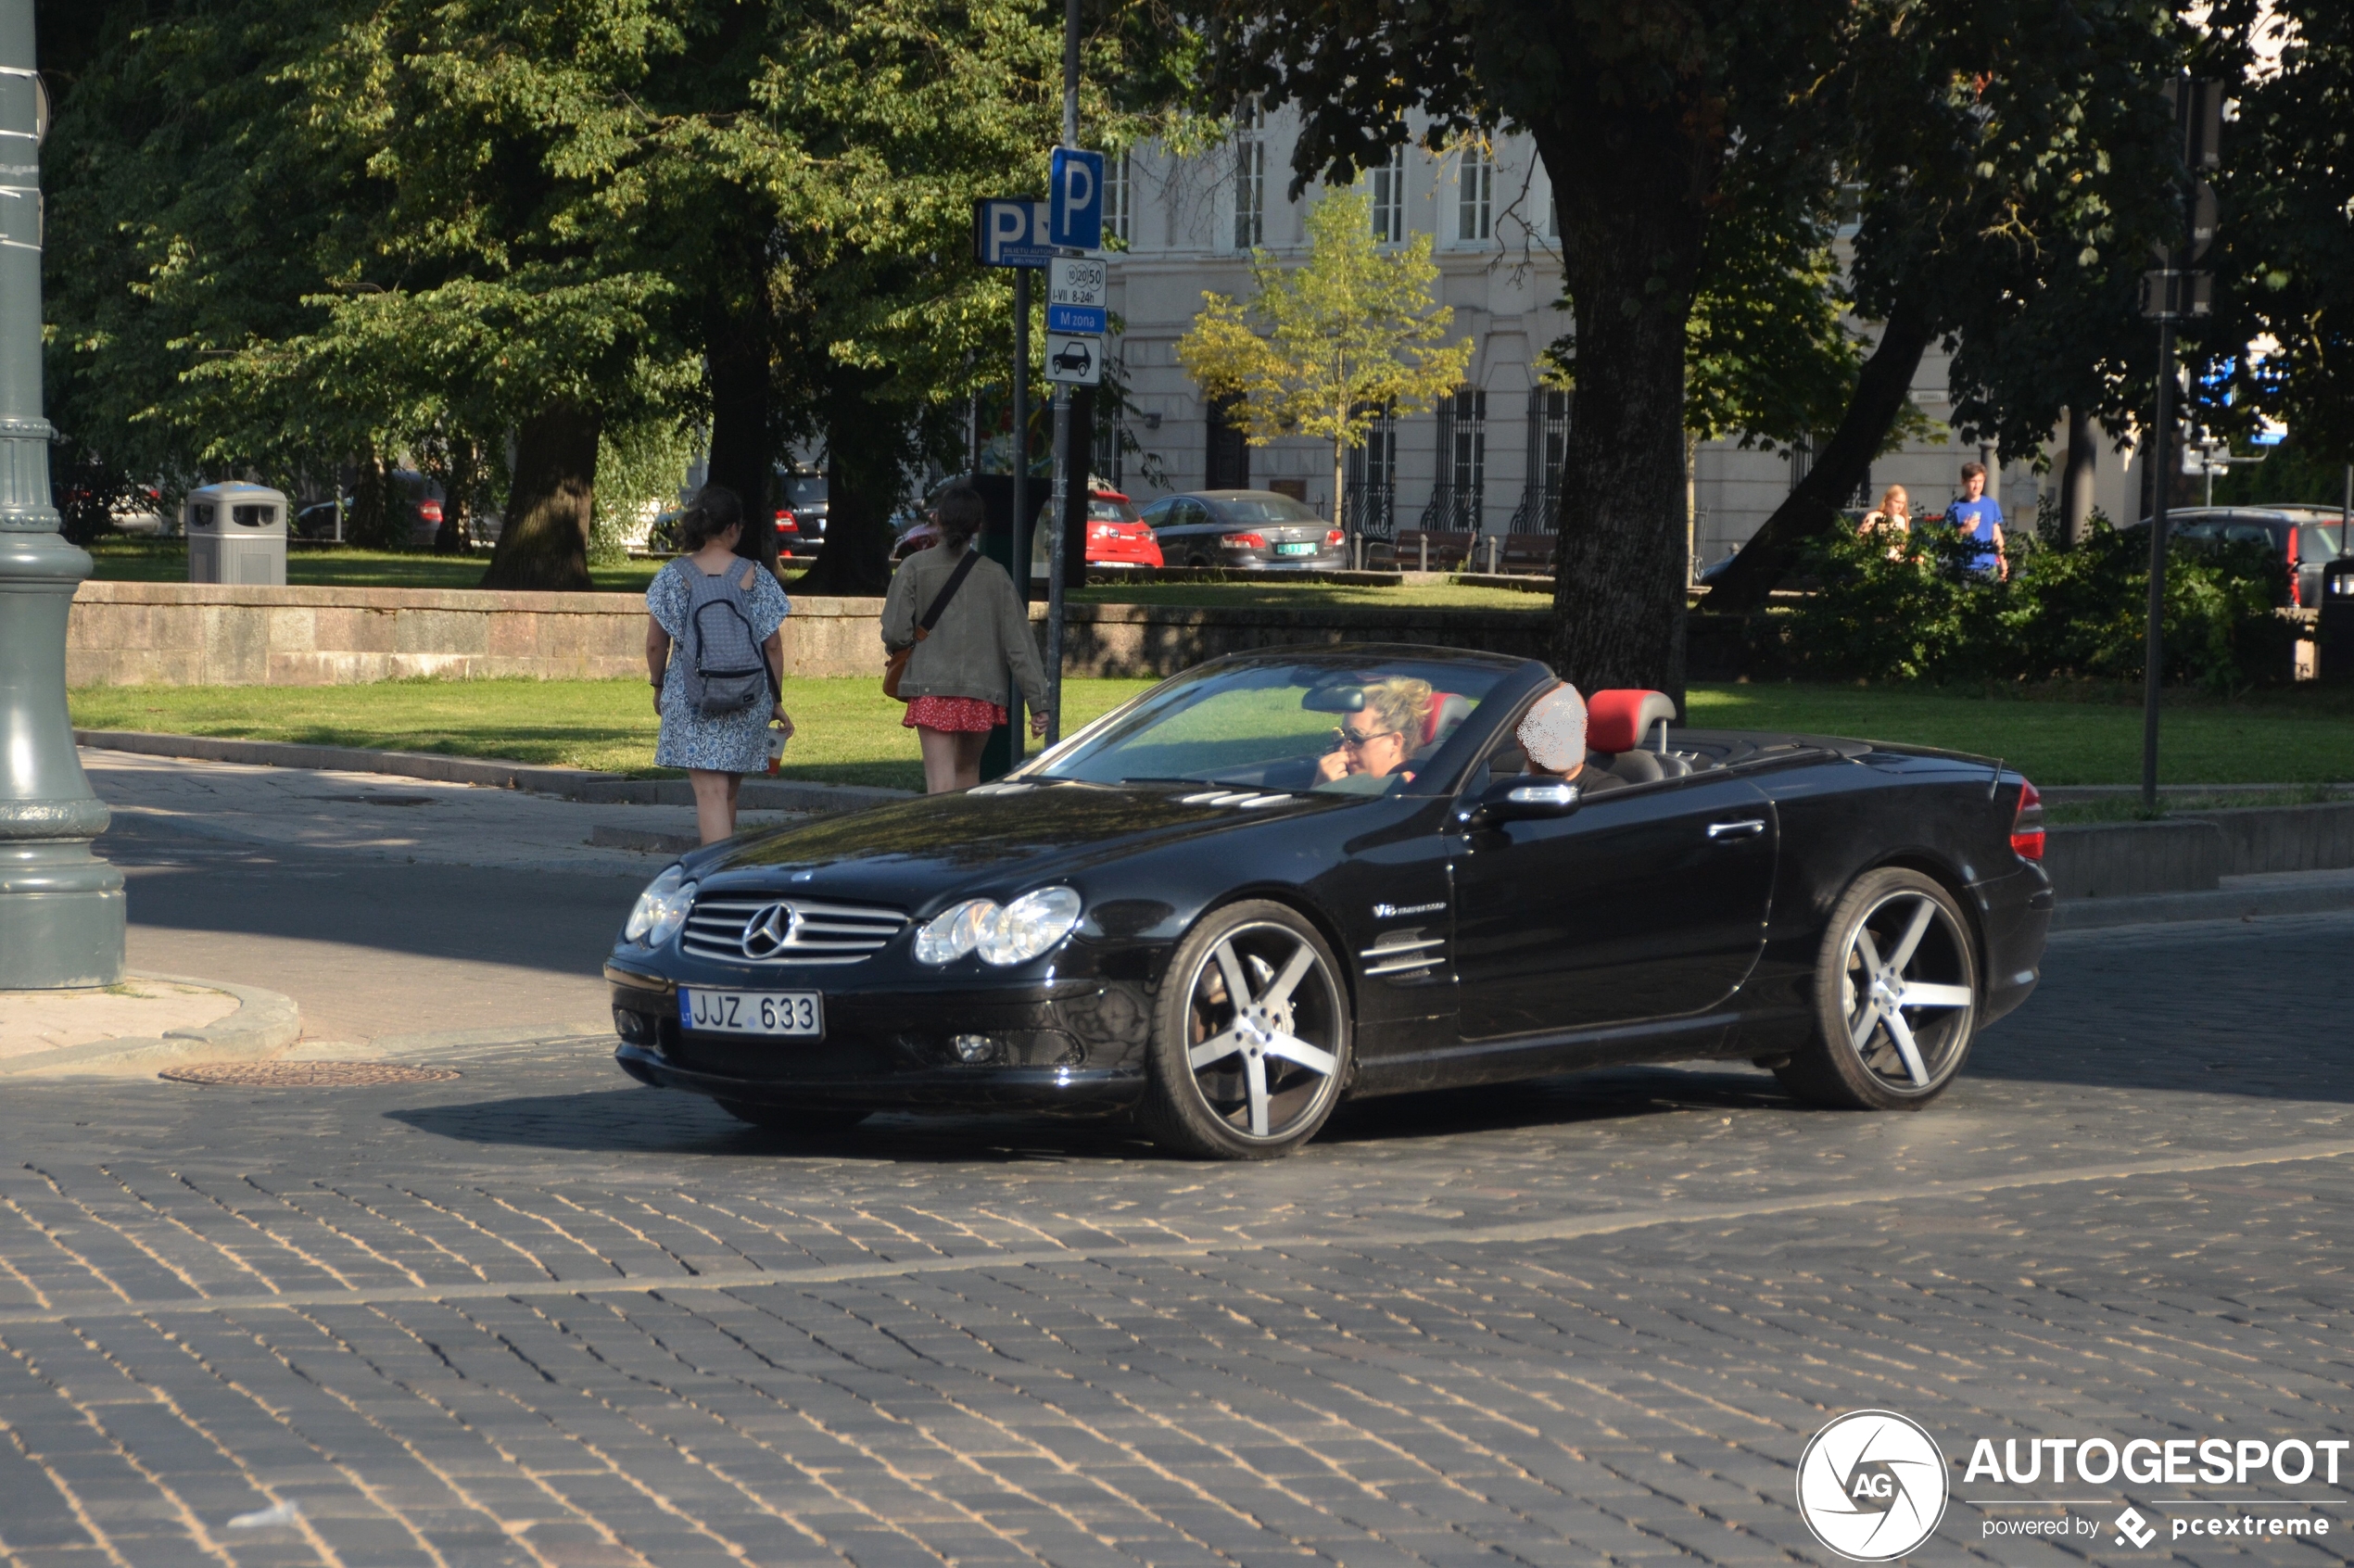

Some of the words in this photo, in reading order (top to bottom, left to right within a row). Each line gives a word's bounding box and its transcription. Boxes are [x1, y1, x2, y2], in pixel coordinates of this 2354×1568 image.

[1063, 159, 1094, 236] P
[990, 203, 1026, 262] P
[1077, 270, 1087, 282] 20
[1089, 269, 1102, 285] 50
[1053, 288, 1068, 301] I-VII
[1072, 290, 1095, 303] 8-24h
[1060, 310, 1070, 325] M
[1072, 315, 1095, 327] zona
[681, 1012, 690, 1022] LT
[695, 994, 741, 1028] JJZ
[761, 997, 814, 1030] 633
